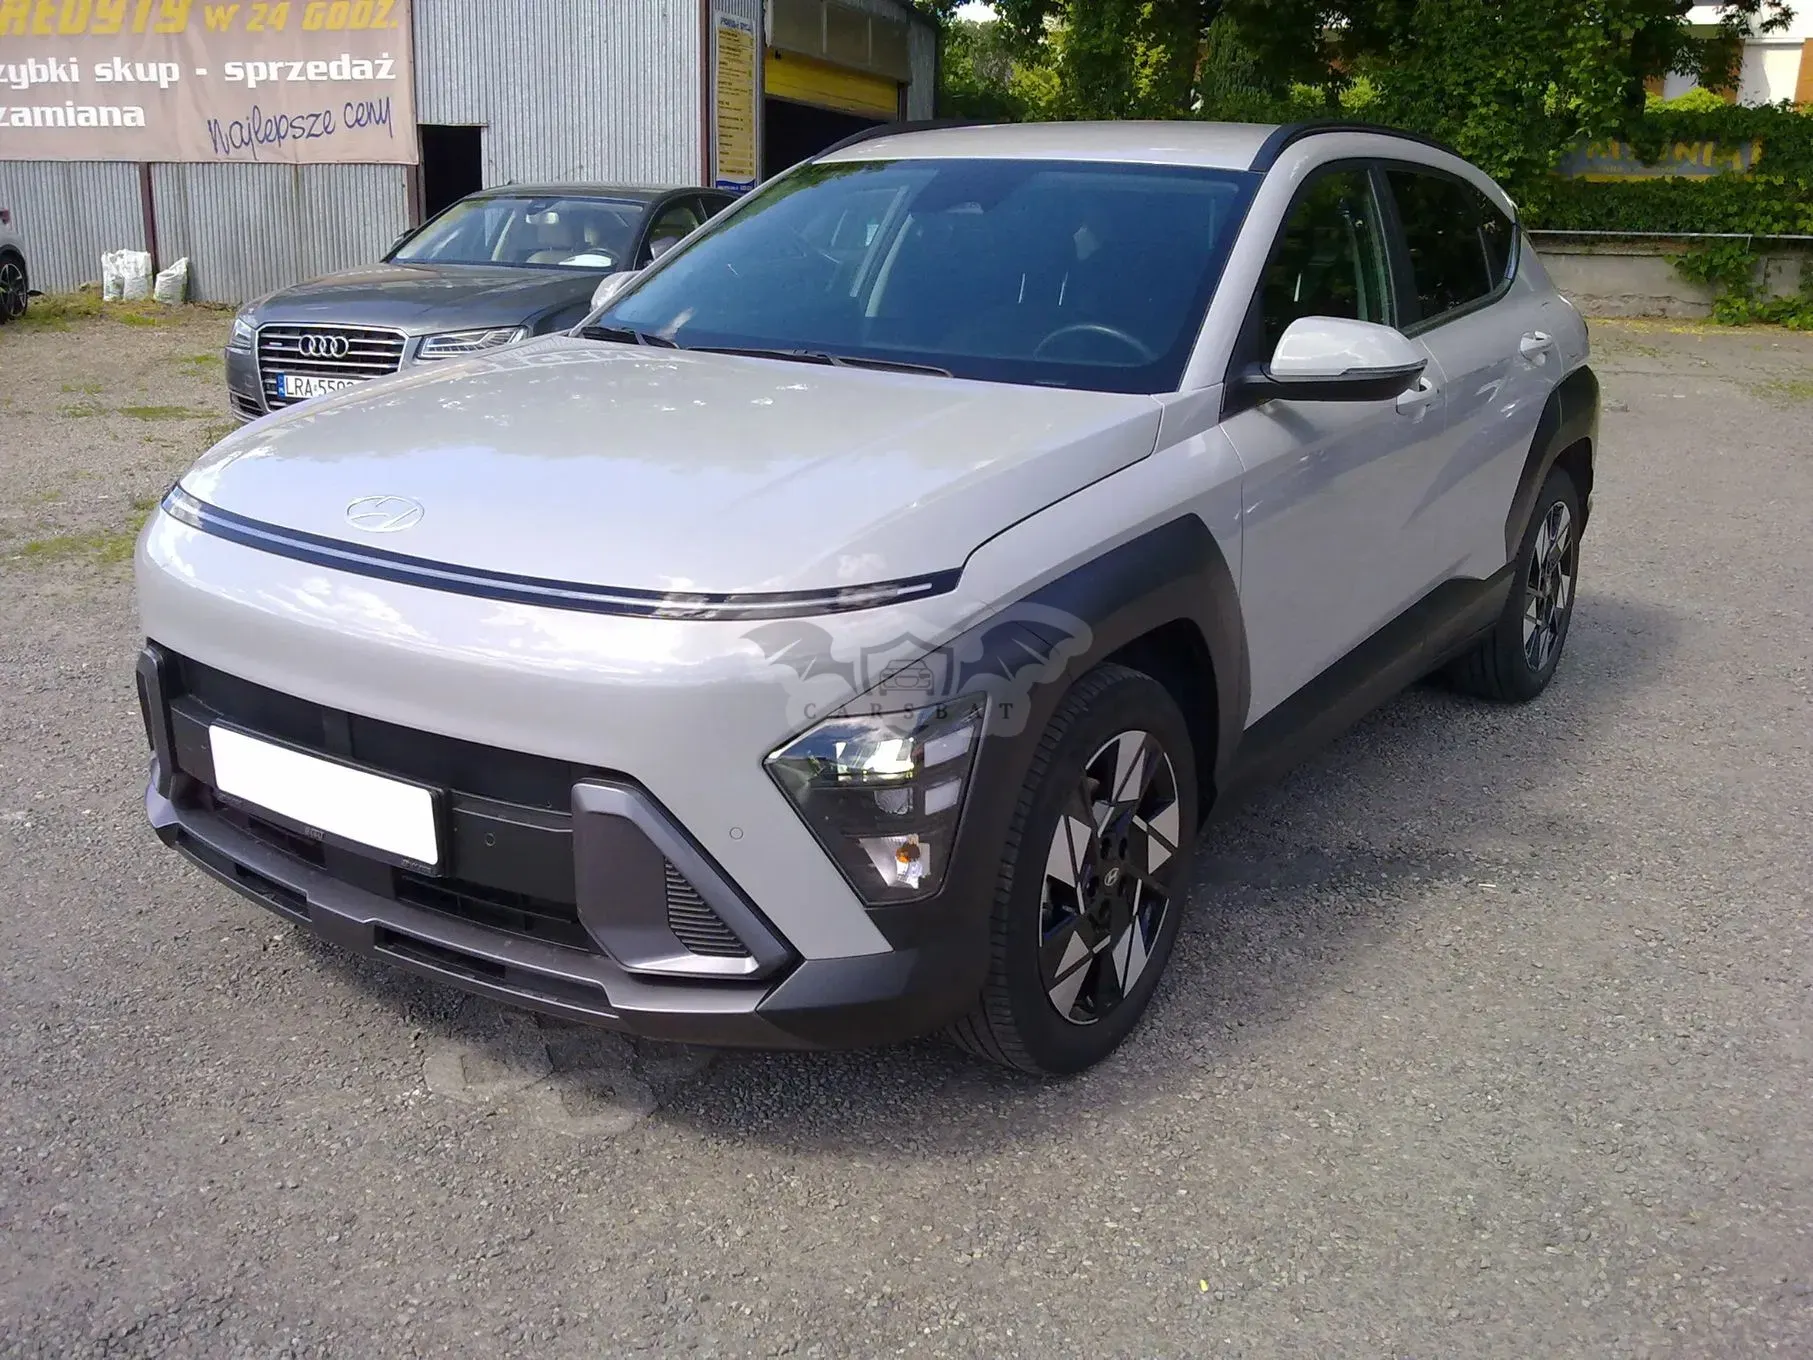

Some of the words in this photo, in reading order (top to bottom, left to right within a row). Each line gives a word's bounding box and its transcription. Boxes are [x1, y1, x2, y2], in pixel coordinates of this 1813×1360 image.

[247, 2, 290, 31] 24
[94, 56, 180, 89] skup
[224, 52, 397, 89] sprzedaż
[343, 96, 394, 139] ceny
[286, 377, 313, 396] LRA
